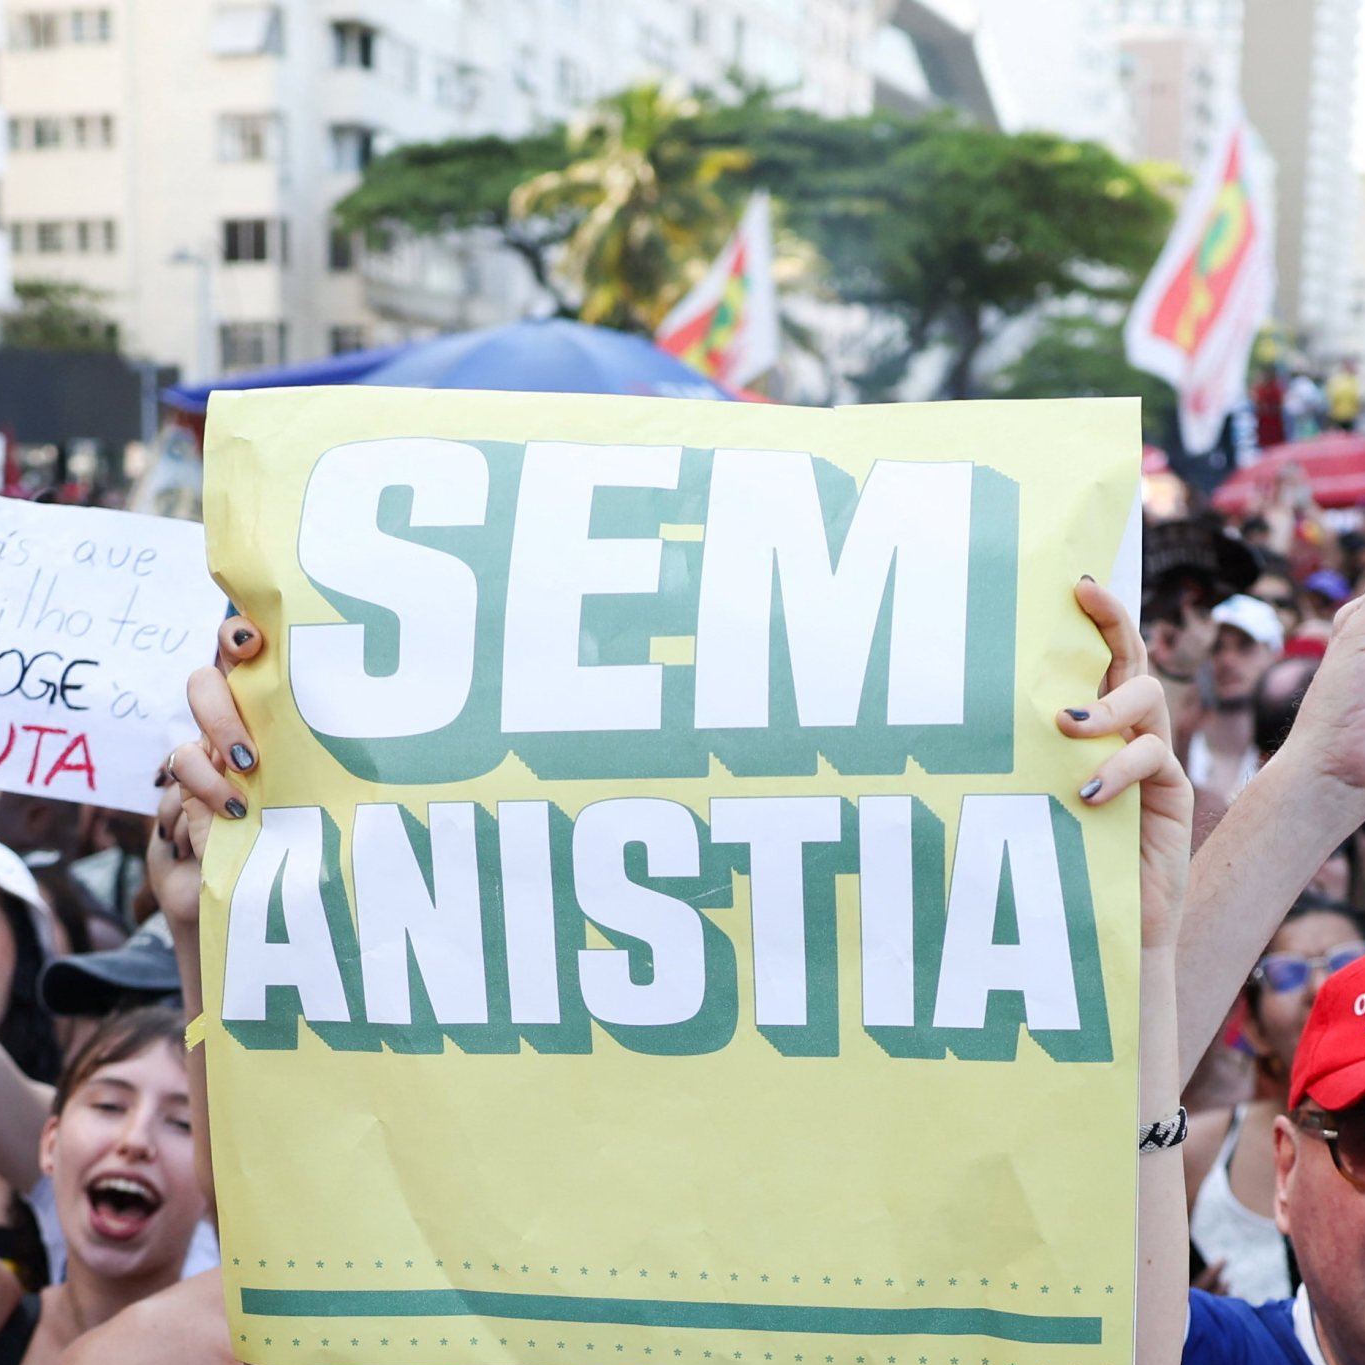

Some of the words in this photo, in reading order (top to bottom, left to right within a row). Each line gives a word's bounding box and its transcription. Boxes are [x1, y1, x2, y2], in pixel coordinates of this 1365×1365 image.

[108, 585, 189, 653] teu
[288, 437, 1005, 770] SEM
[221, 794, 1105, 1050] ANISTIA
